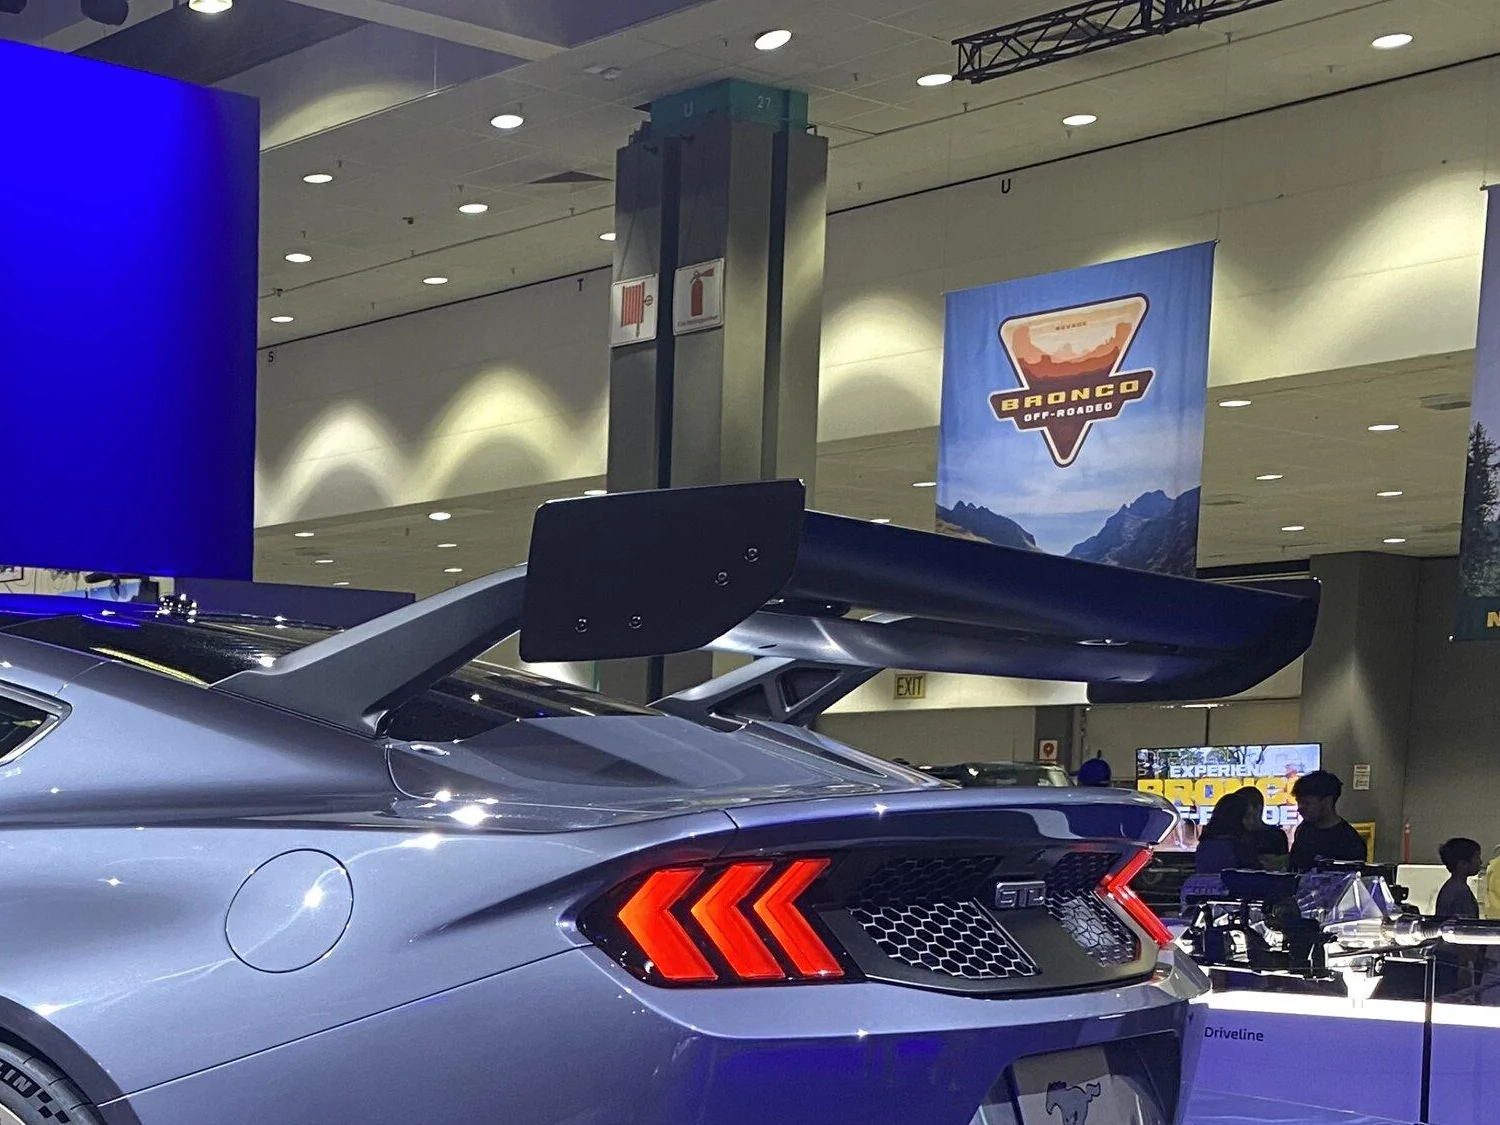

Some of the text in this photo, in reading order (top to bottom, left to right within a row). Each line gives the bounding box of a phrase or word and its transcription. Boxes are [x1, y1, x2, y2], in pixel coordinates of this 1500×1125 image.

[757, 95, 772, 109] 27
[1001, 178, 1011, 194] U
[576, 278, 585, 292] T
[1001, 379, 1140, 411] BRONCO
[1023, 402, 1113, 422] OFF-ROADEO
[896, 676, 924, 697] EXIT
[1204, 1027, 1264, 1042] Driveline
